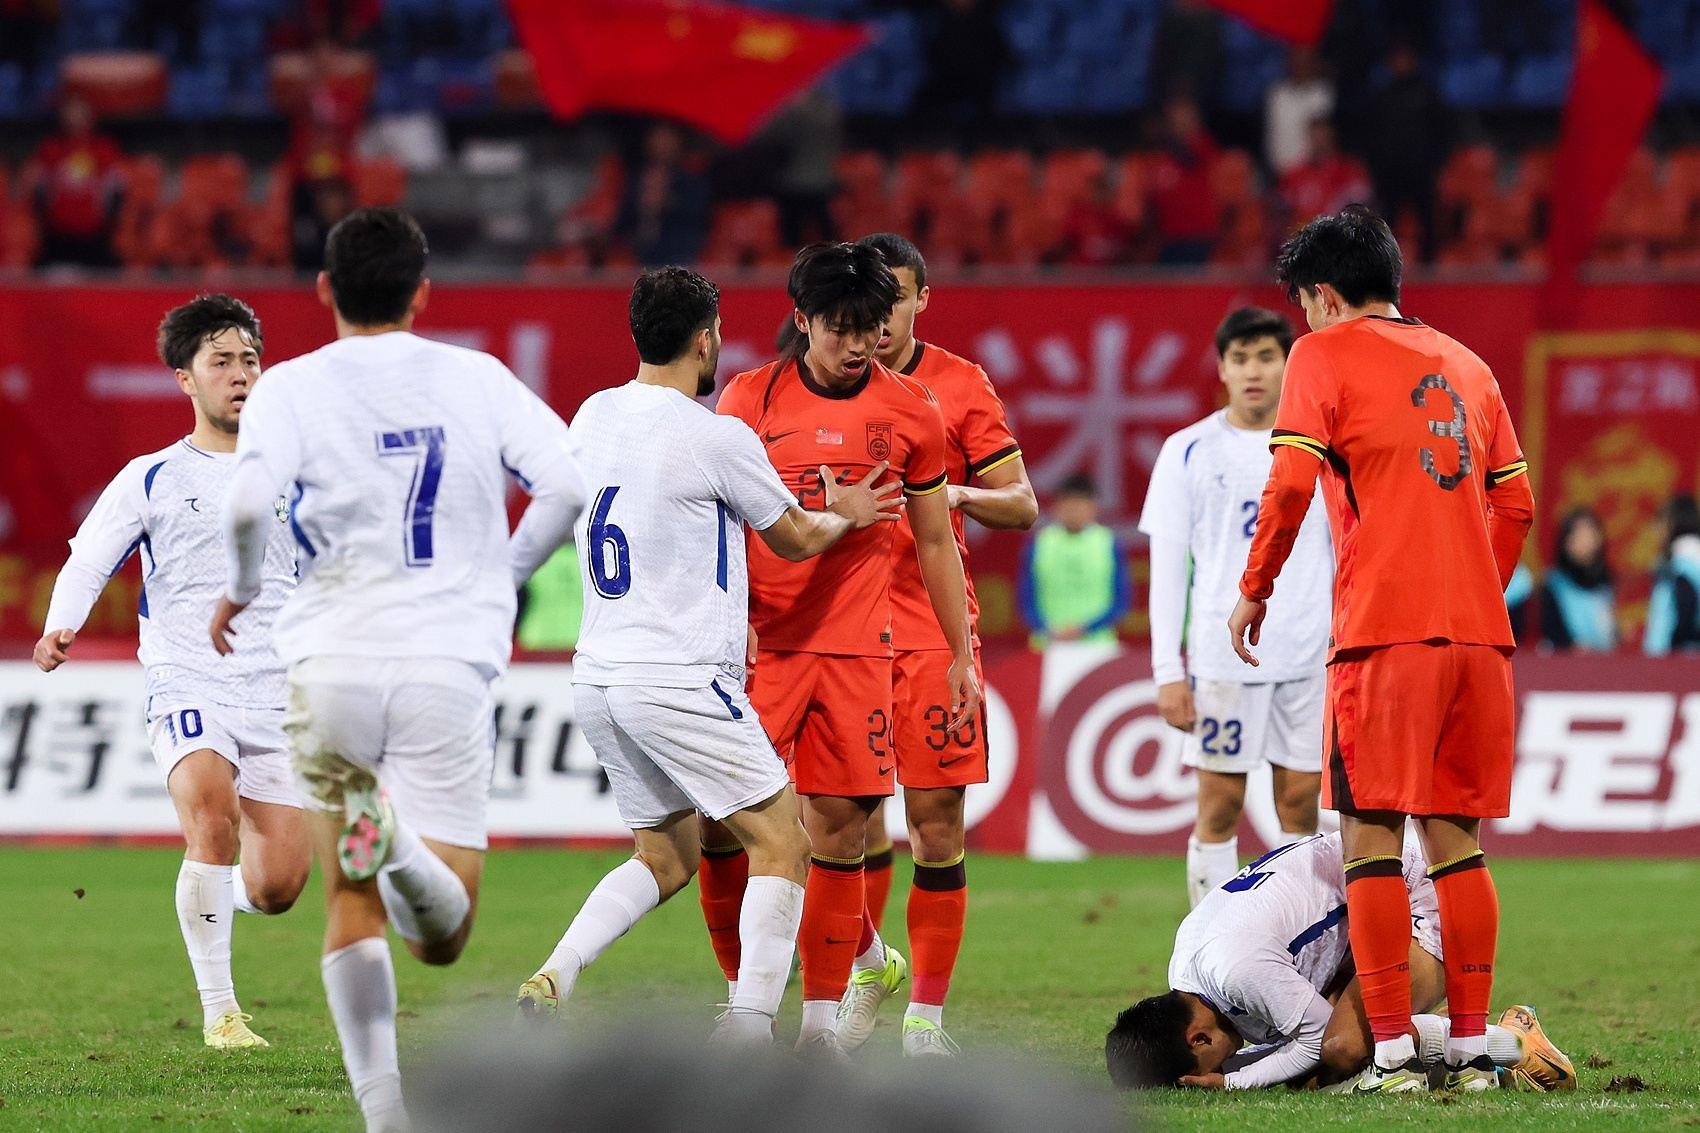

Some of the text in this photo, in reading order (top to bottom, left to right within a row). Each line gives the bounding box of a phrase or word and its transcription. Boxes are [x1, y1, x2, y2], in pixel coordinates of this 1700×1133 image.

[1410, 373, 1472, 491] 3
[376, 425, 446, 568] 7
[587, 486, 631, 600] 6
[1241, 500, 1260, 539] 2
[164, 709, 204, 746] 10
[1201, 717, 1242, 756] 23
[1493, 690, 1700, 833] 足
